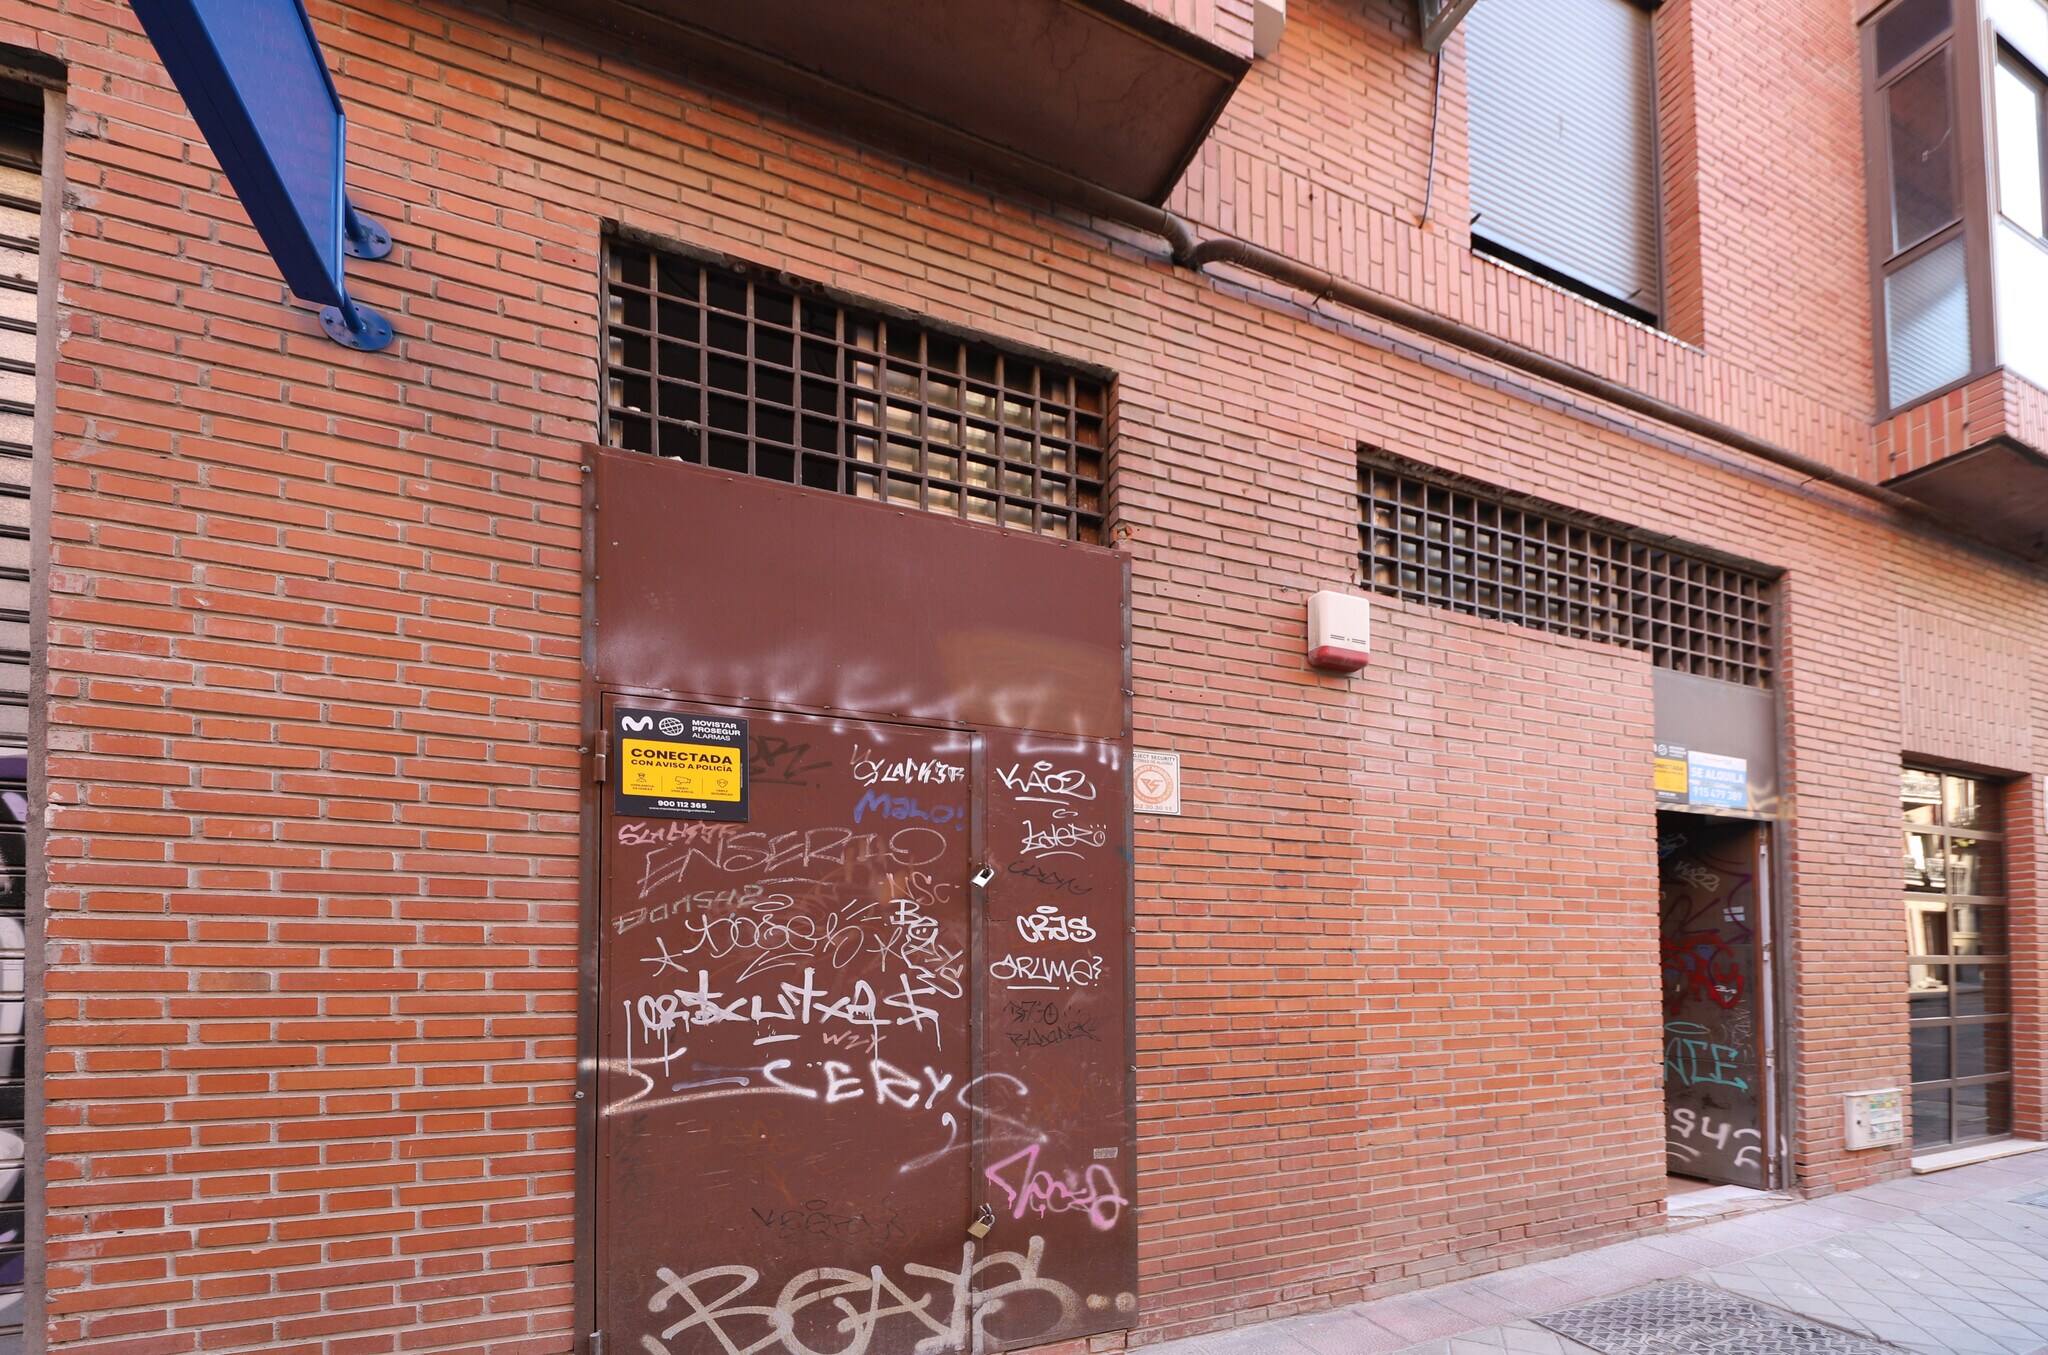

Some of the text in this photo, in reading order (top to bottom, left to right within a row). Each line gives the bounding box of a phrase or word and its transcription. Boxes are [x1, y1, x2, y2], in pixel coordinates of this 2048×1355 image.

[692, 719, 737, 730] MOVISTAR
[692, 726, 741, 736] PROSEGUR
[692, 732, 731, 741] ALARMAS
[631, 748, 732, 764] CONECTADA
[696, 764, 733, 772] POLICÍA
[1691, 767, 1704, 778] SE
[1705, 770, 1745, 784] ALQUILA
[1693, 787, 1710, 797] 915
